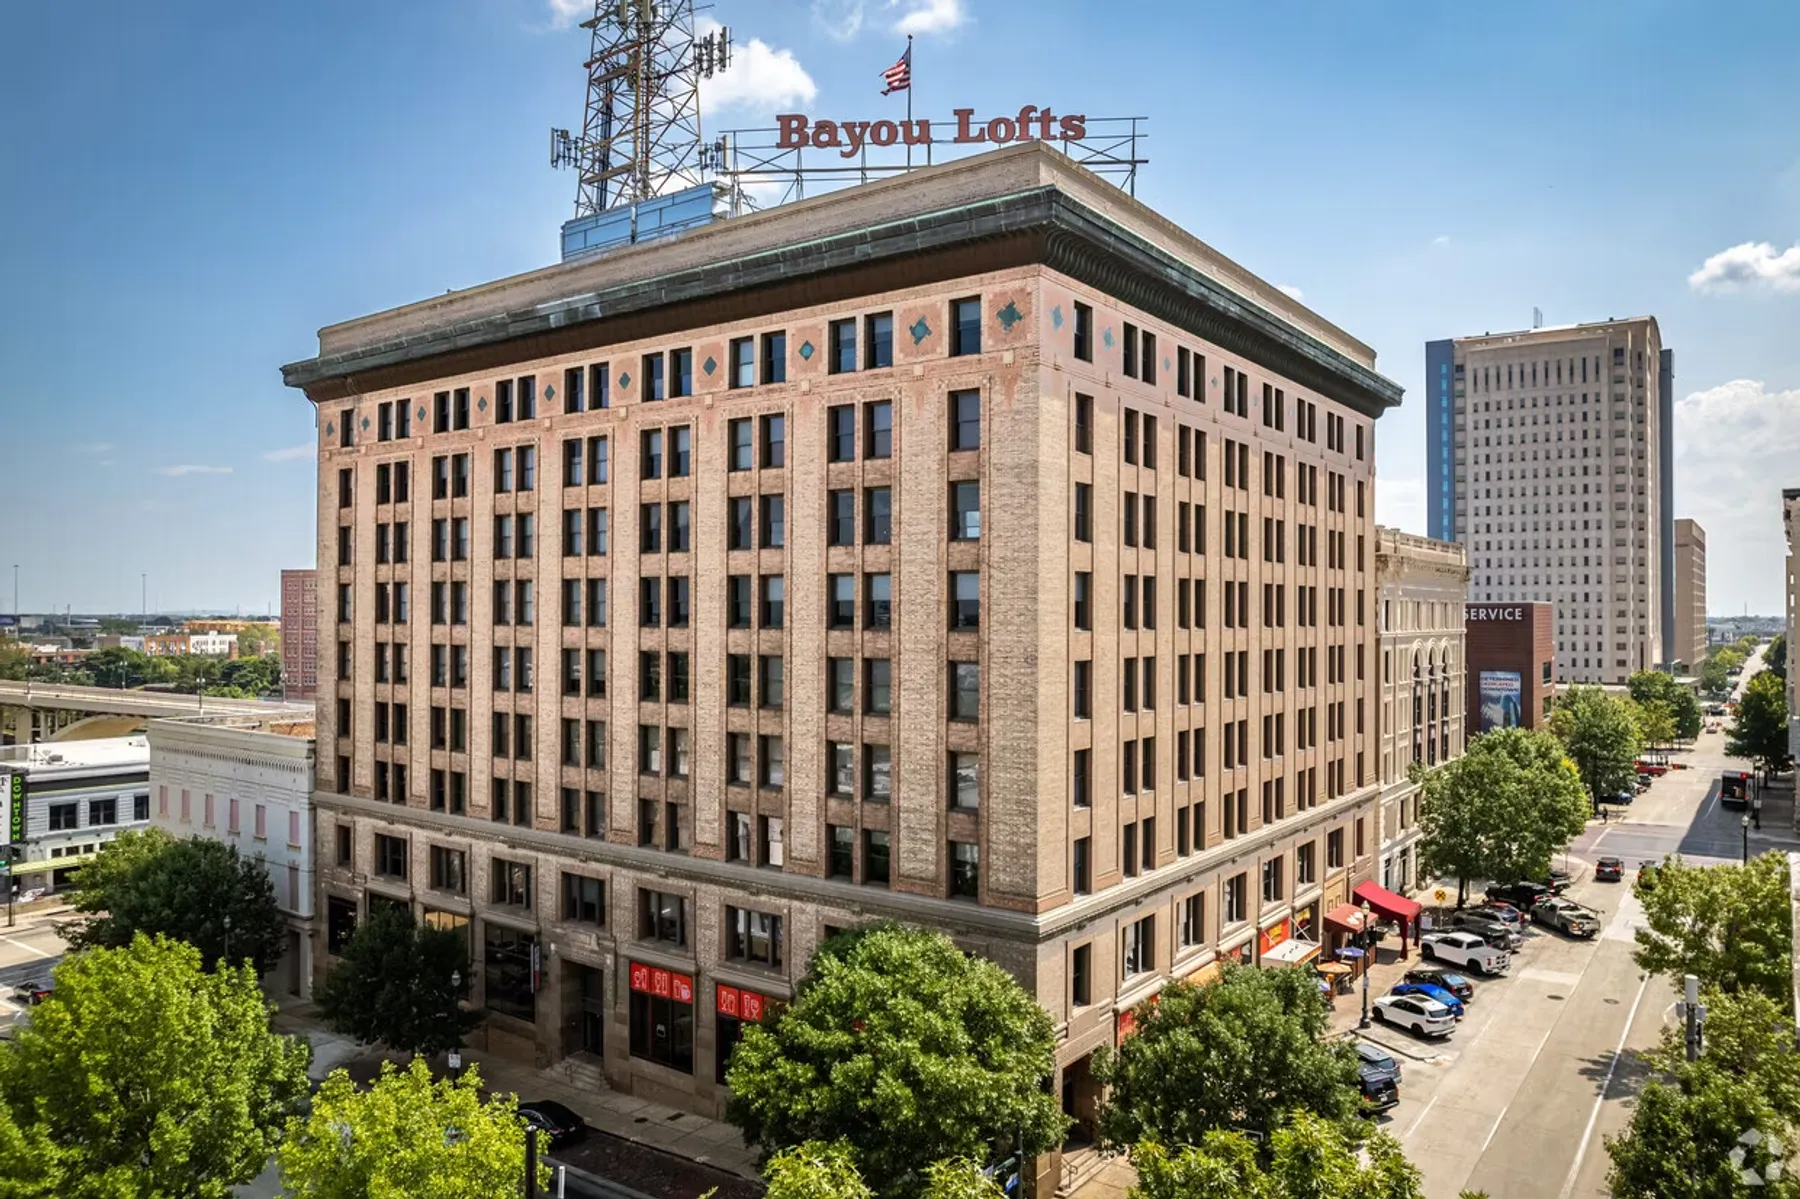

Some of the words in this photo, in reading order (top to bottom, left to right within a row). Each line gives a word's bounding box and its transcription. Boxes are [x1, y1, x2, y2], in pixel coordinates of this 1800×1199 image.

[775, 114, 933, 158] Bayou
[953, 105, 1086, 144] Lofts
[12, 776, 22, 840] DOWNTOWN
